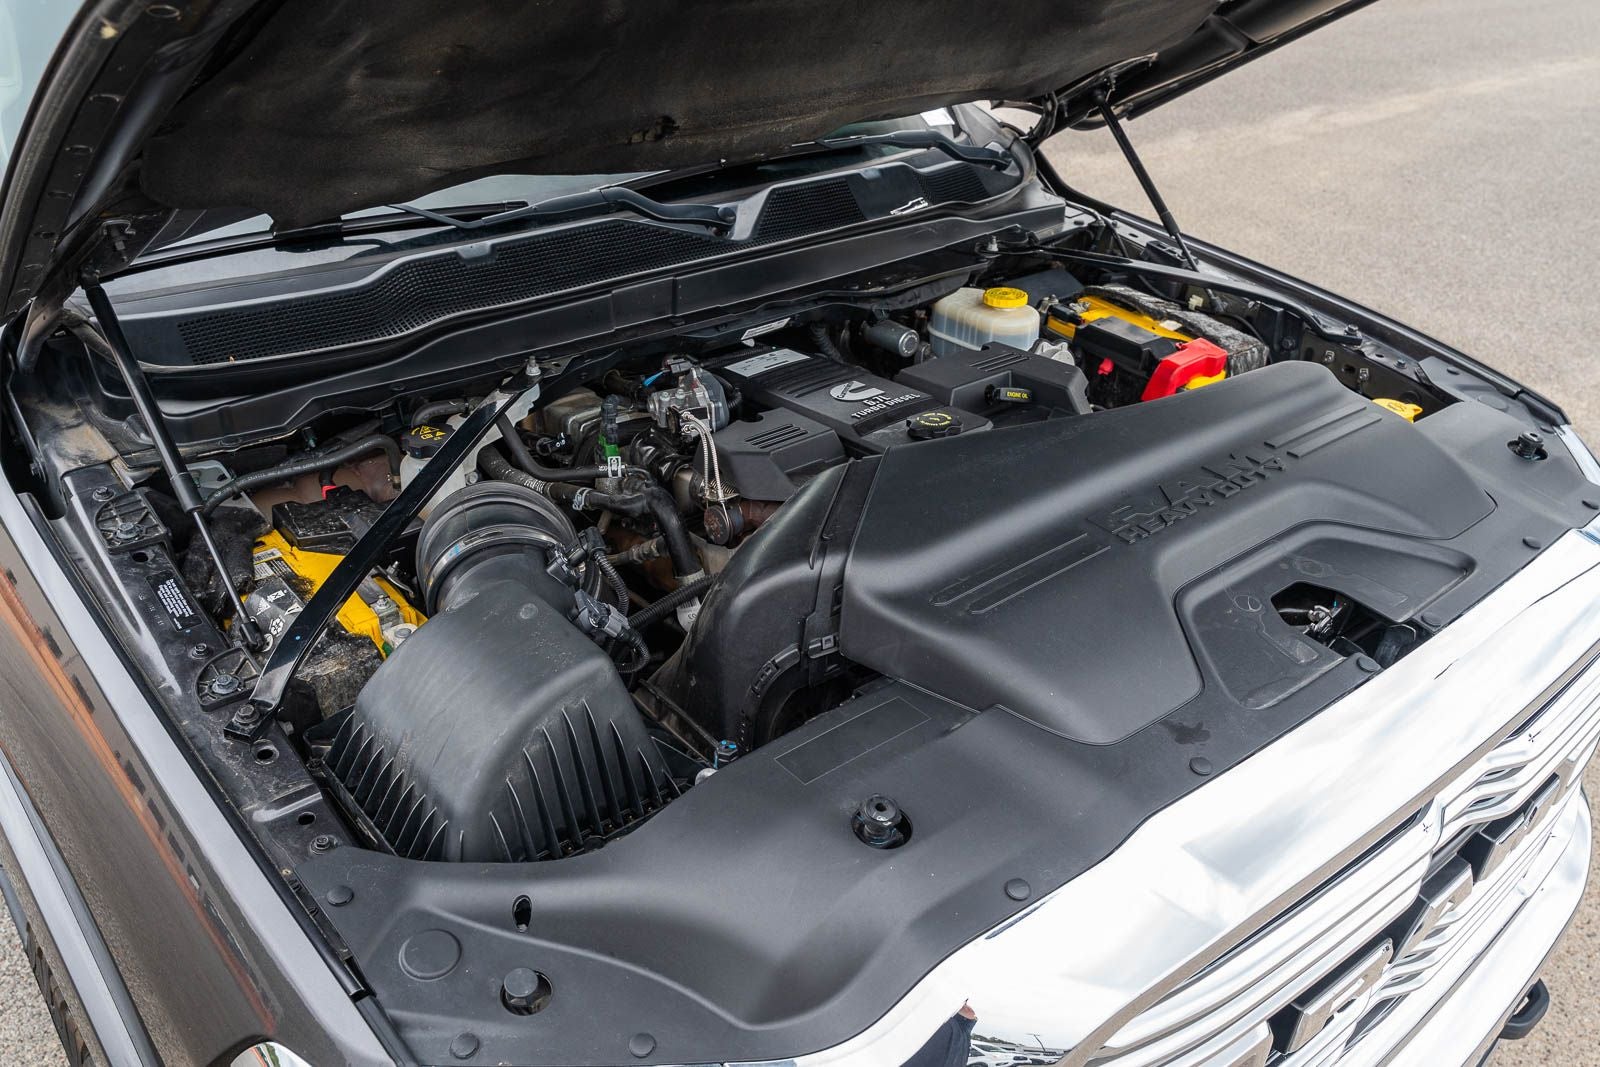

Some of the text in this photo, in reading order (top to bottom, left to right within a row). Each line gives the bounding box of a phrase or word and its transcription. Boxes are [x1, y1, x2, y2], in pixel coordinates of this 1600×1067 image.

[851, 393, 921, 418] TURBO DIESEL
[862, 395, 891, 406] 6.7L
[1117, 456, 1287, 545] HEAVY DUTY
